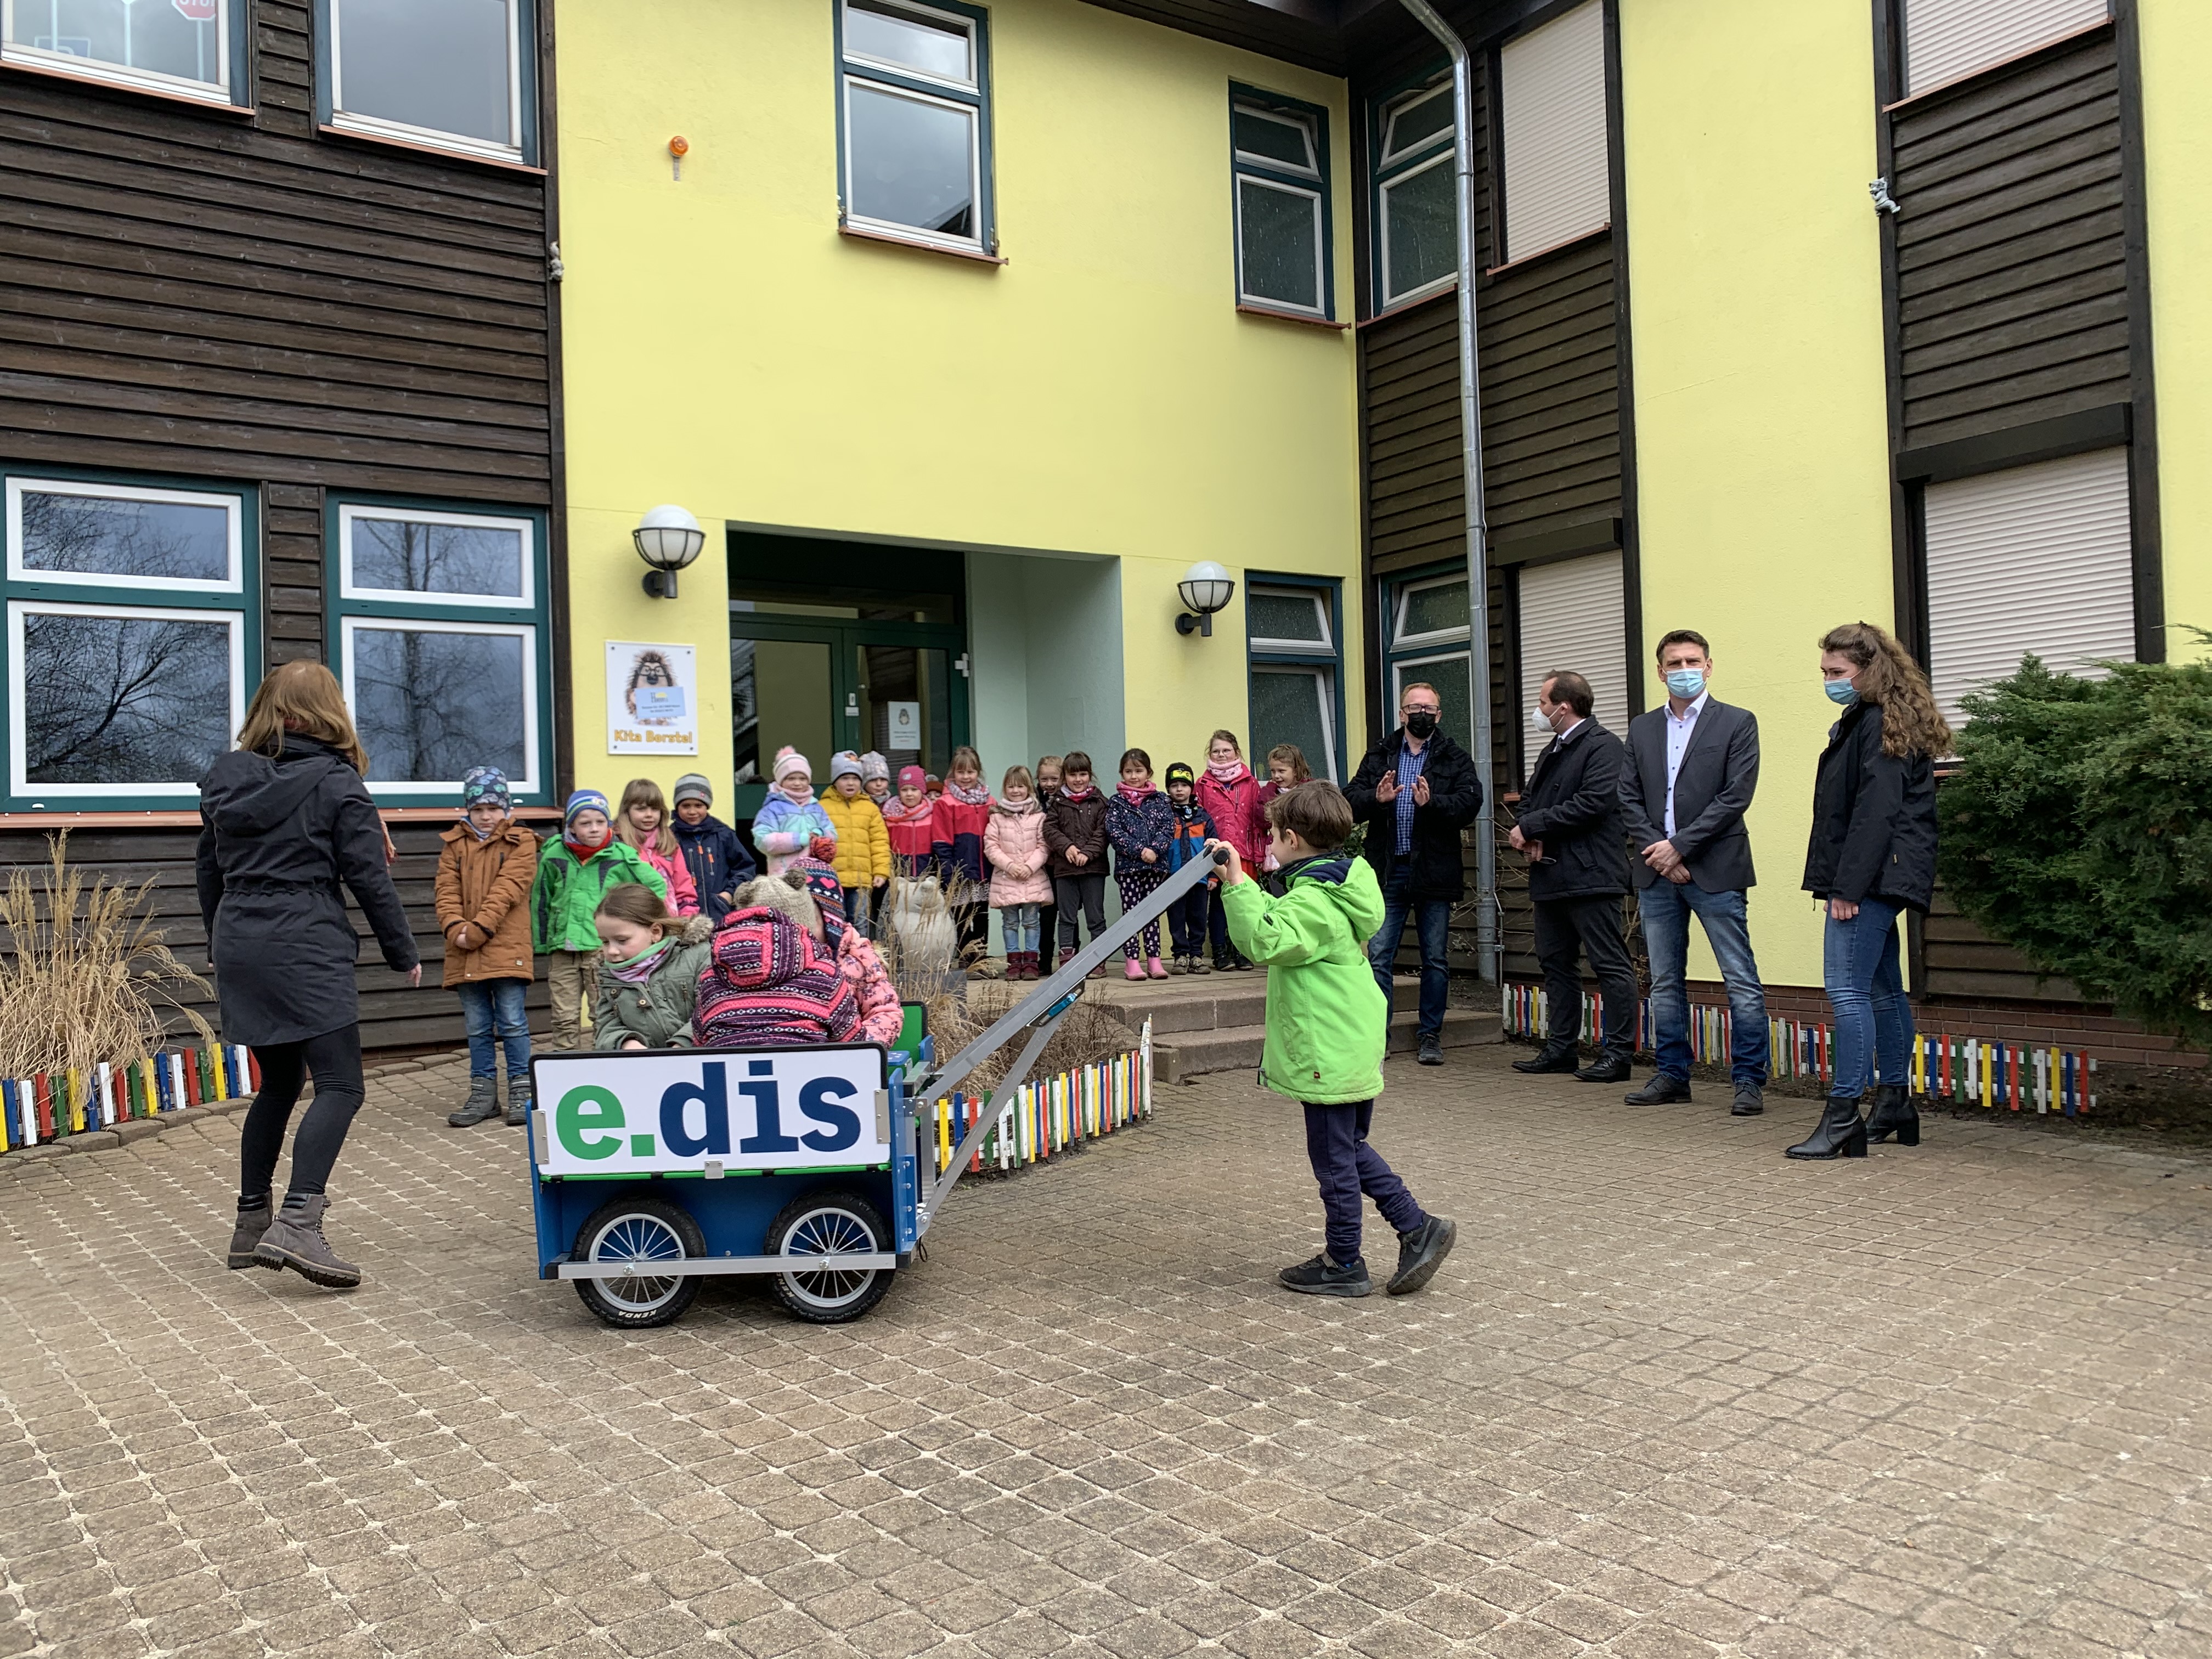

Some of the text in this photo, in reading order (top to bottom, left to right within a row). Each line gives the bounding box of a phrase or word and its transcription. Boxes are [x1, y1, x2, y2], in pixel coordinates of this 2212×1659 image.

[614, 730, 642, 742] Kita
[556, 1059, 861, 1160] e.dis
[618, 1310, 657, 1318] KENDA
